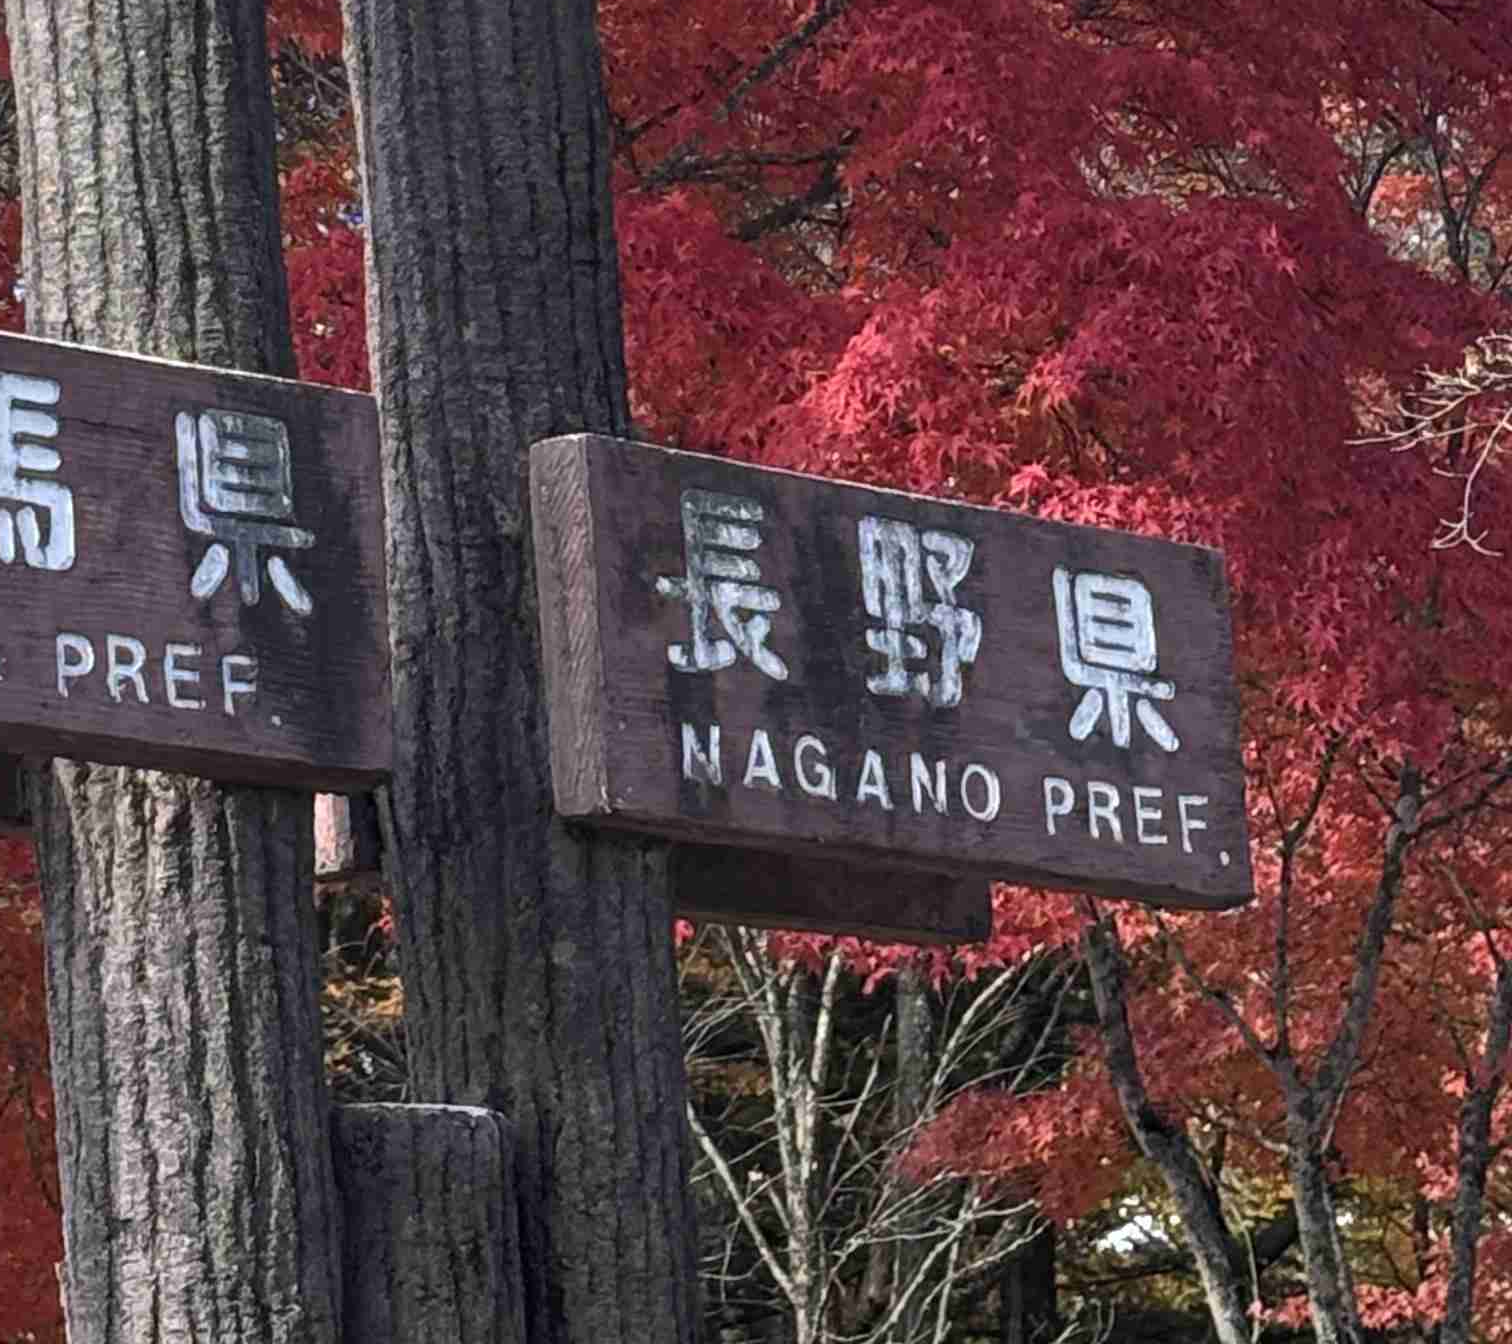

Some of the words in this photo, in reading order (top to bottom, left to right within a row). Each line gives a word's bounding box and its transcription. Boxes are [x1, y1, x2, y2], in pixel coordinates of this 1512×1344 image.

[55, 632, 283, 727] PREF.
[655, 488, 1181, 753] 長野県
[679, 723, 1002, 822] NAGANO
[1042, 776, 1232, 866] PREF.
